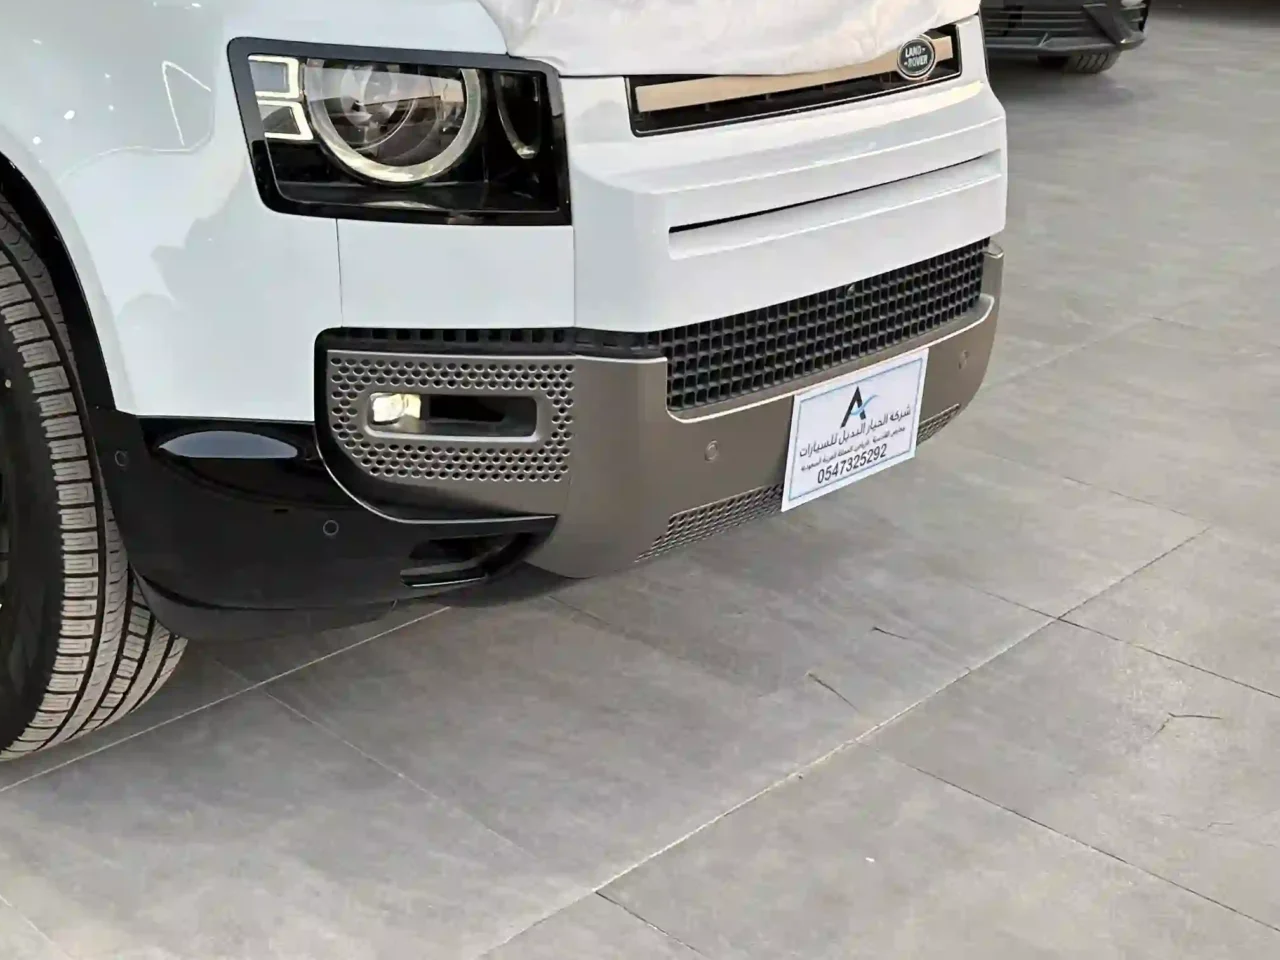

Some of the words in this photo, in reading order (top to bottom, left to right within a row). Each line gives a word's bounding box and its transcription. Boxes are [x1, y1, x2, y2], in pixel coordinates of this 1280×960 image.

[905, 45, 923, 58] LAND
[907, 54, 928, 68] ROVER
[817, 443, 887, 484] 0547325292
